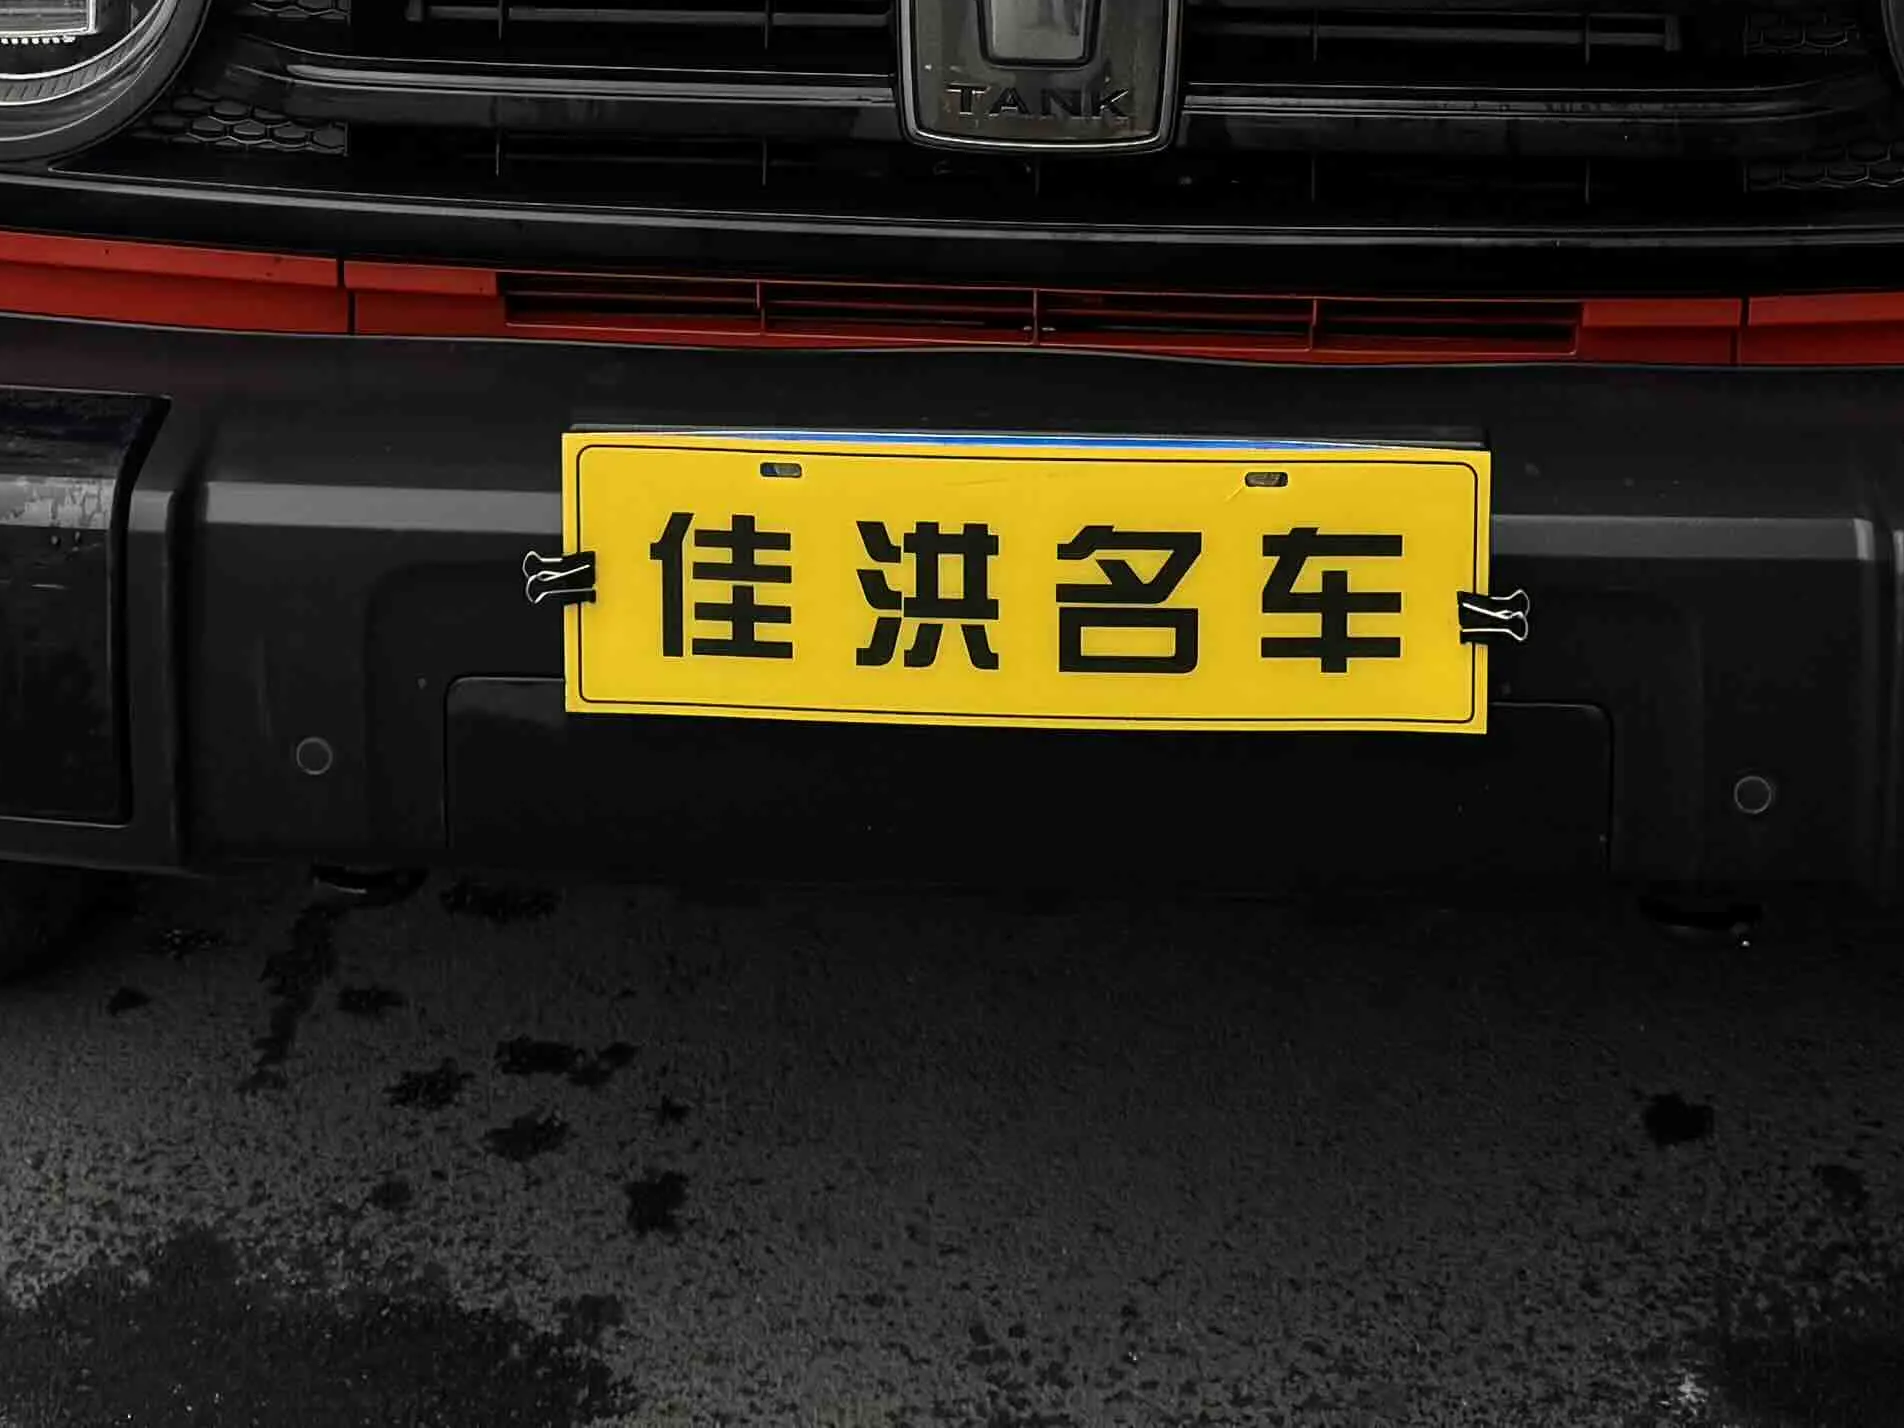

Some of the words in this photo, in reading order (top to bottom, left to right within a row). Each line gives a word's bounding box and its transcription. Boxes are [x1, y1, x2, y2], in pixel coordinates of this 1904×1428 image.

[945, 82, 1130, 121] TANK
[648, 510, 1405, 676] 佳洪名车
